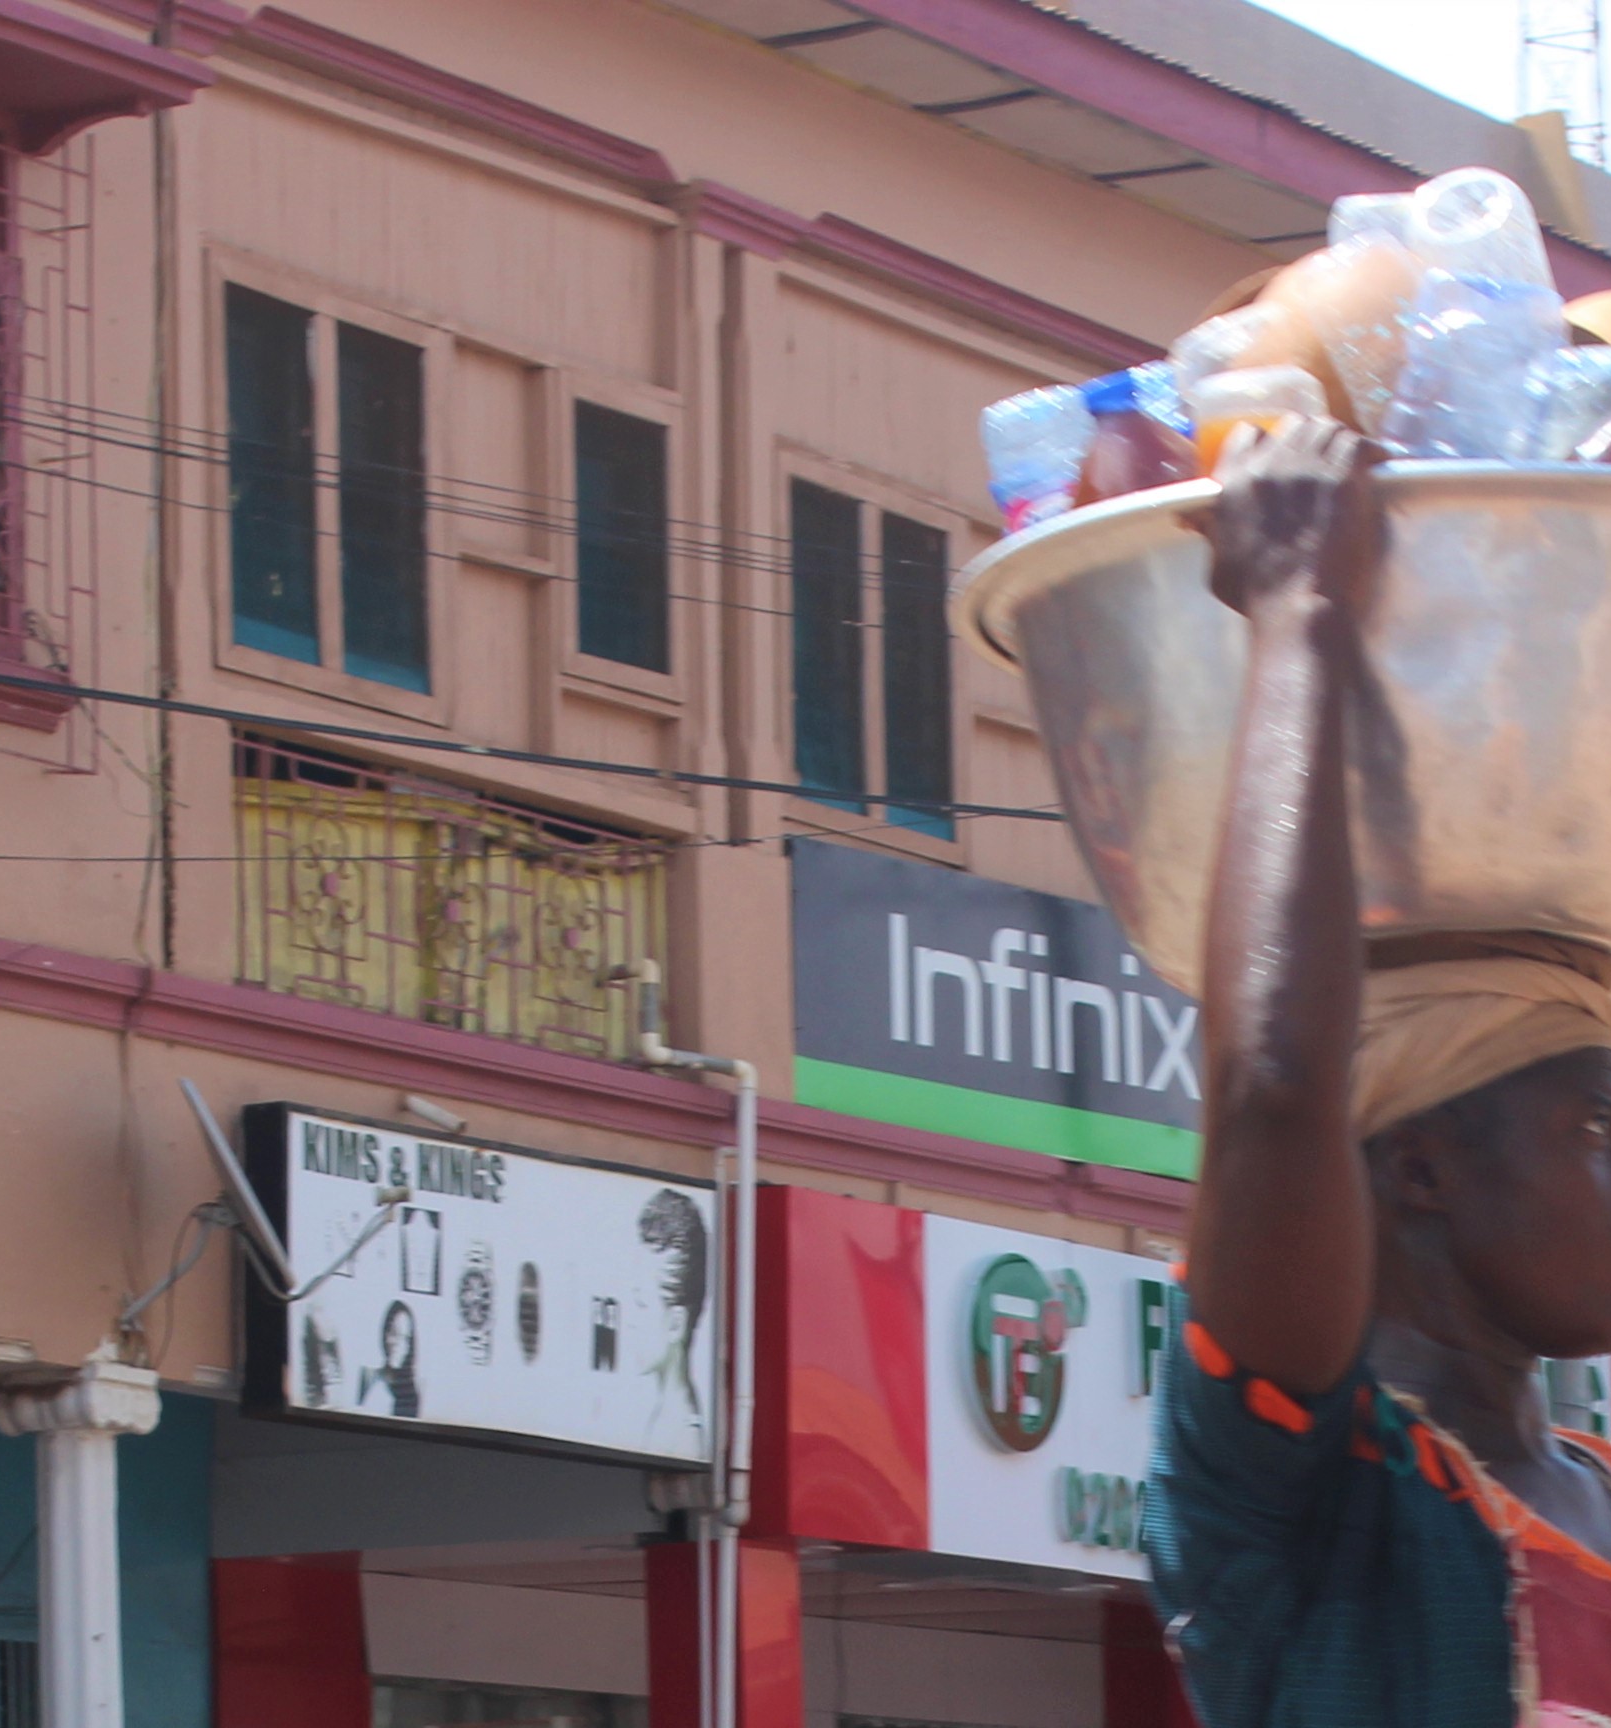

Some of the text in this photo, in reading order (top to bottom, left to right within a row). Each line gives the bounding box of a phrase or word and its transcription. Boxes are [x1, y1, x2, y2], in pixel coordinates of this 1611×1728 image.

[888, 912, 1201, 1101] Infinix
[303, 1121, 507, 1203] KIMS & KINGS
